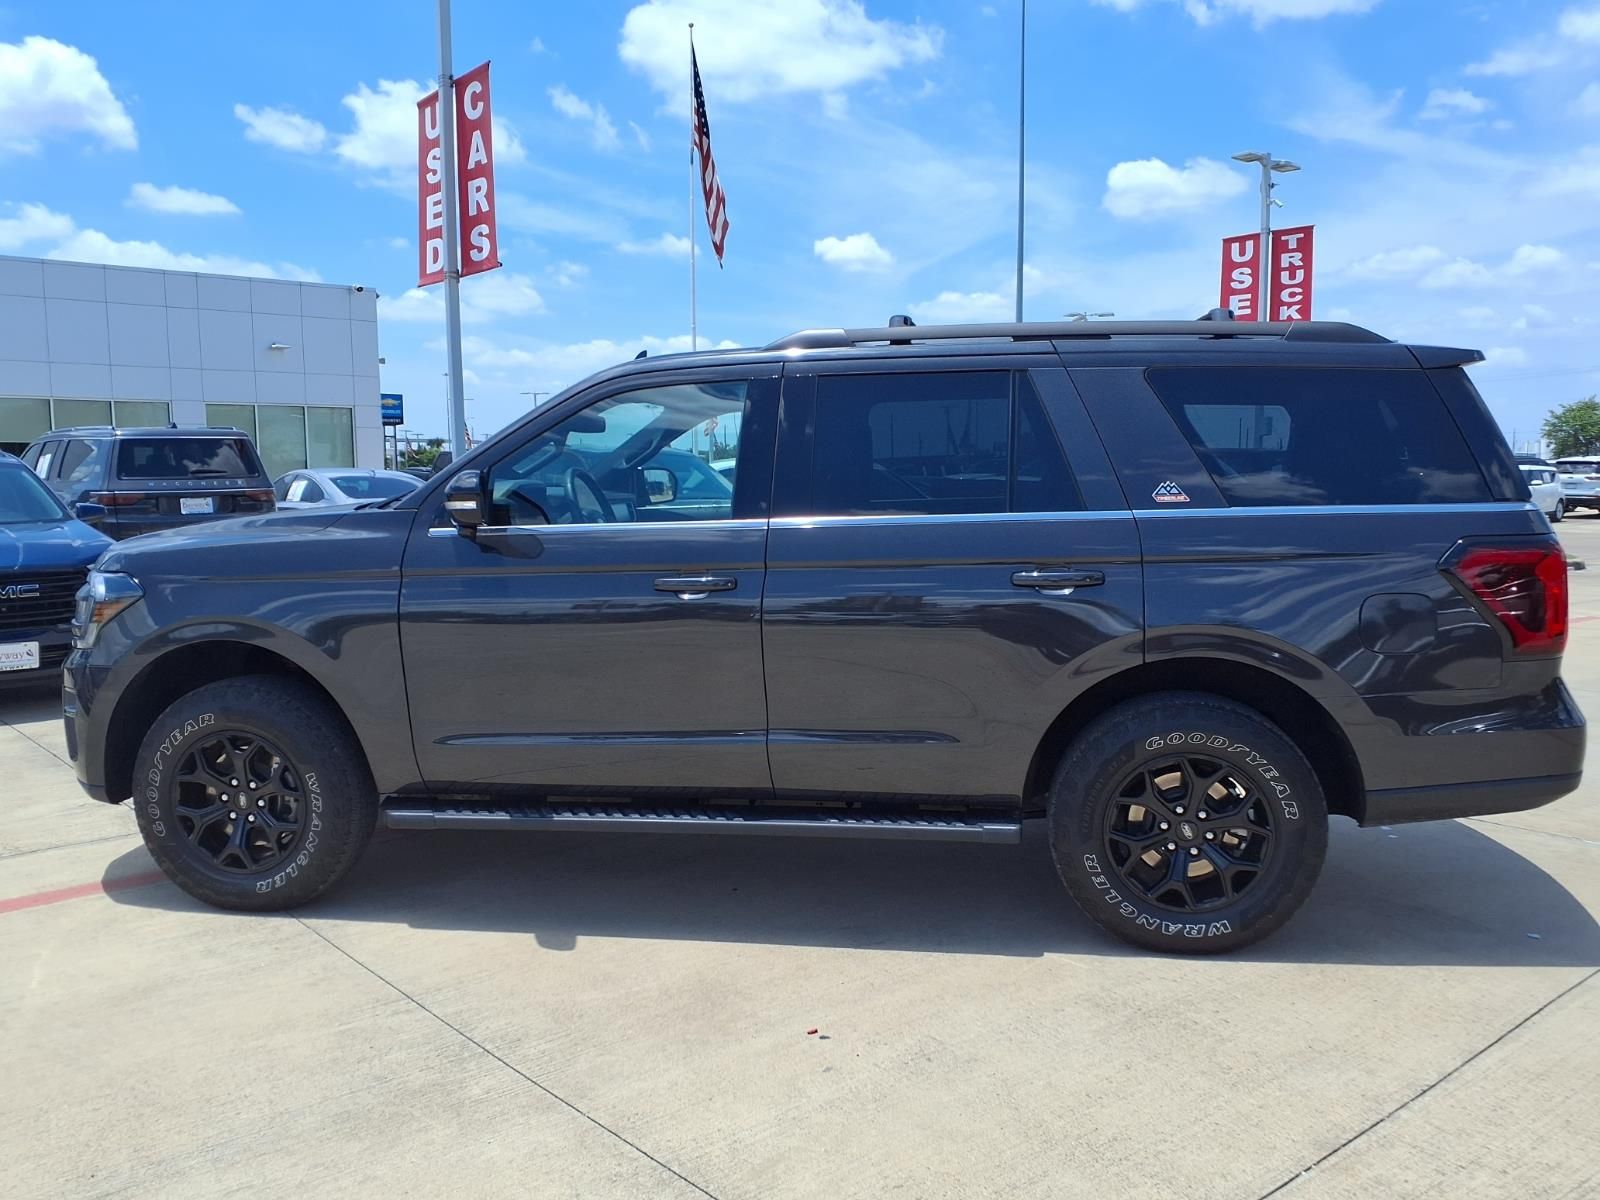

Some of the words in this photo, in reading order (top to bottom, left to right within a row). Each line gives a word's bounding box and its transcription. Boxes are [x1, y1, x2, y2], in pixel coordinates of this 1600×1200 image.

[425, 102, 443, 274] USED
[463, 81, 491, 262] CARS
[1229, 240, 1254, 316] USE
[1280, 233, 1304, 321] TRUCK
[0, 584, 40, 599] MC
[146, 713, 215, 837] GOODYEAR
[1145, 732, 1299, 820] GOODYEAR
[255, 772, 323, 893] WRANGLER
[1083, 854, 1232, 938] WRANGLER
